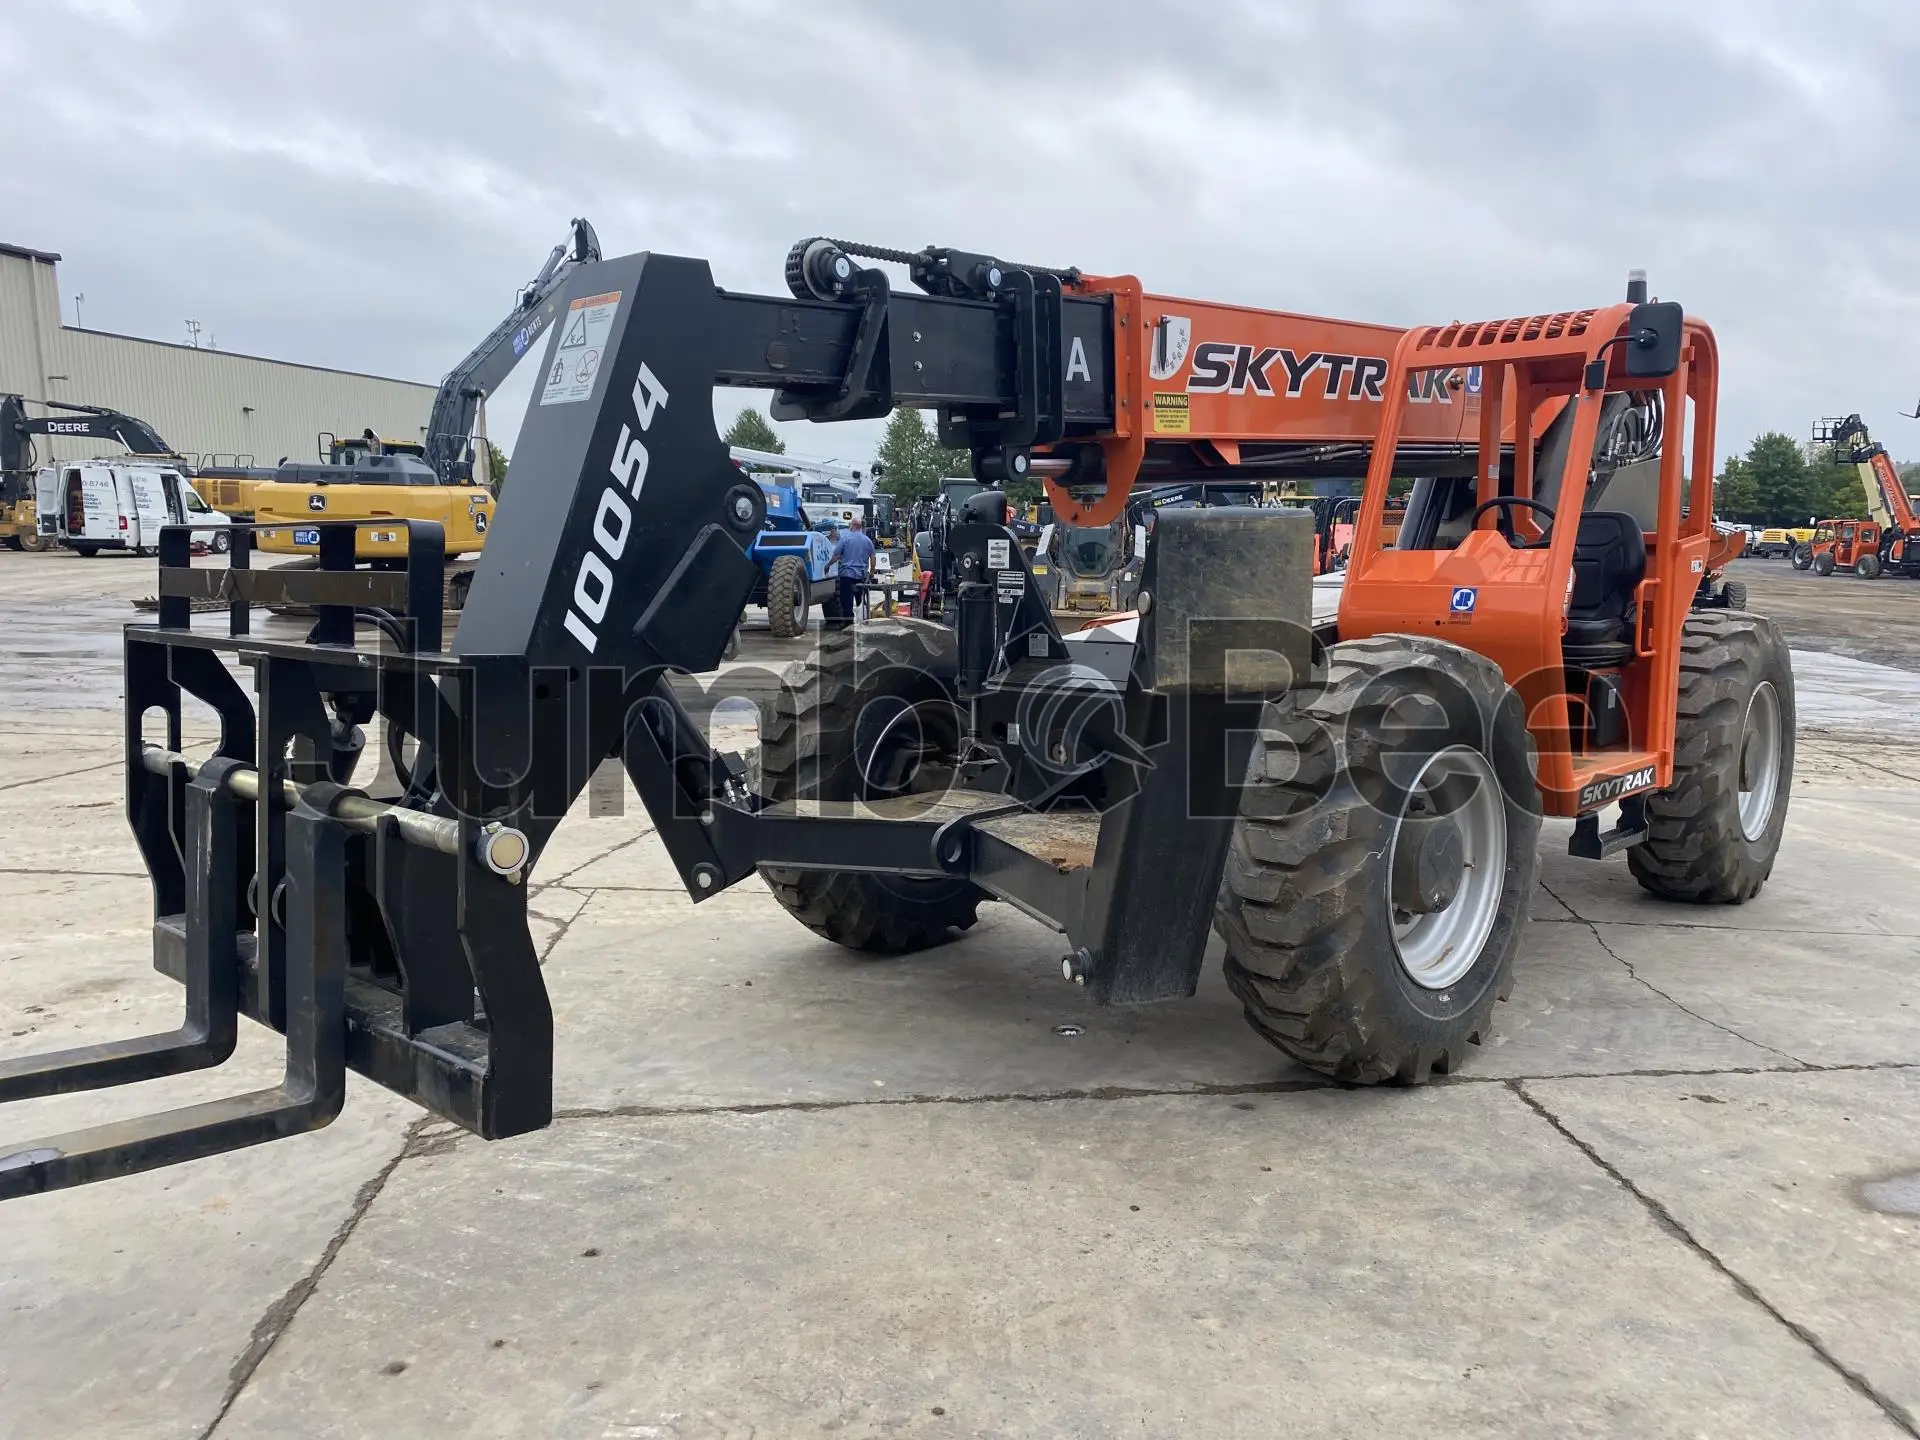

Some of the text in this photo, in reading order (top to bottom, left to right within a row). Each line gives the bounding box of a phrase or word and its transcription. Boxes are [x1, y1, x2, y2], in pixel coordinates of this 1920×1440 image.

[1066, 336, 1092, 382] A
[1155, 395, 1188, 406] WARNING
[47, 421, 90, 432] DEERE
[563, 360, 669, 654] 10054
[1161, 494, 1184, 505] DEERE
[1581, 767, 1654, 805] SKYTRAK
